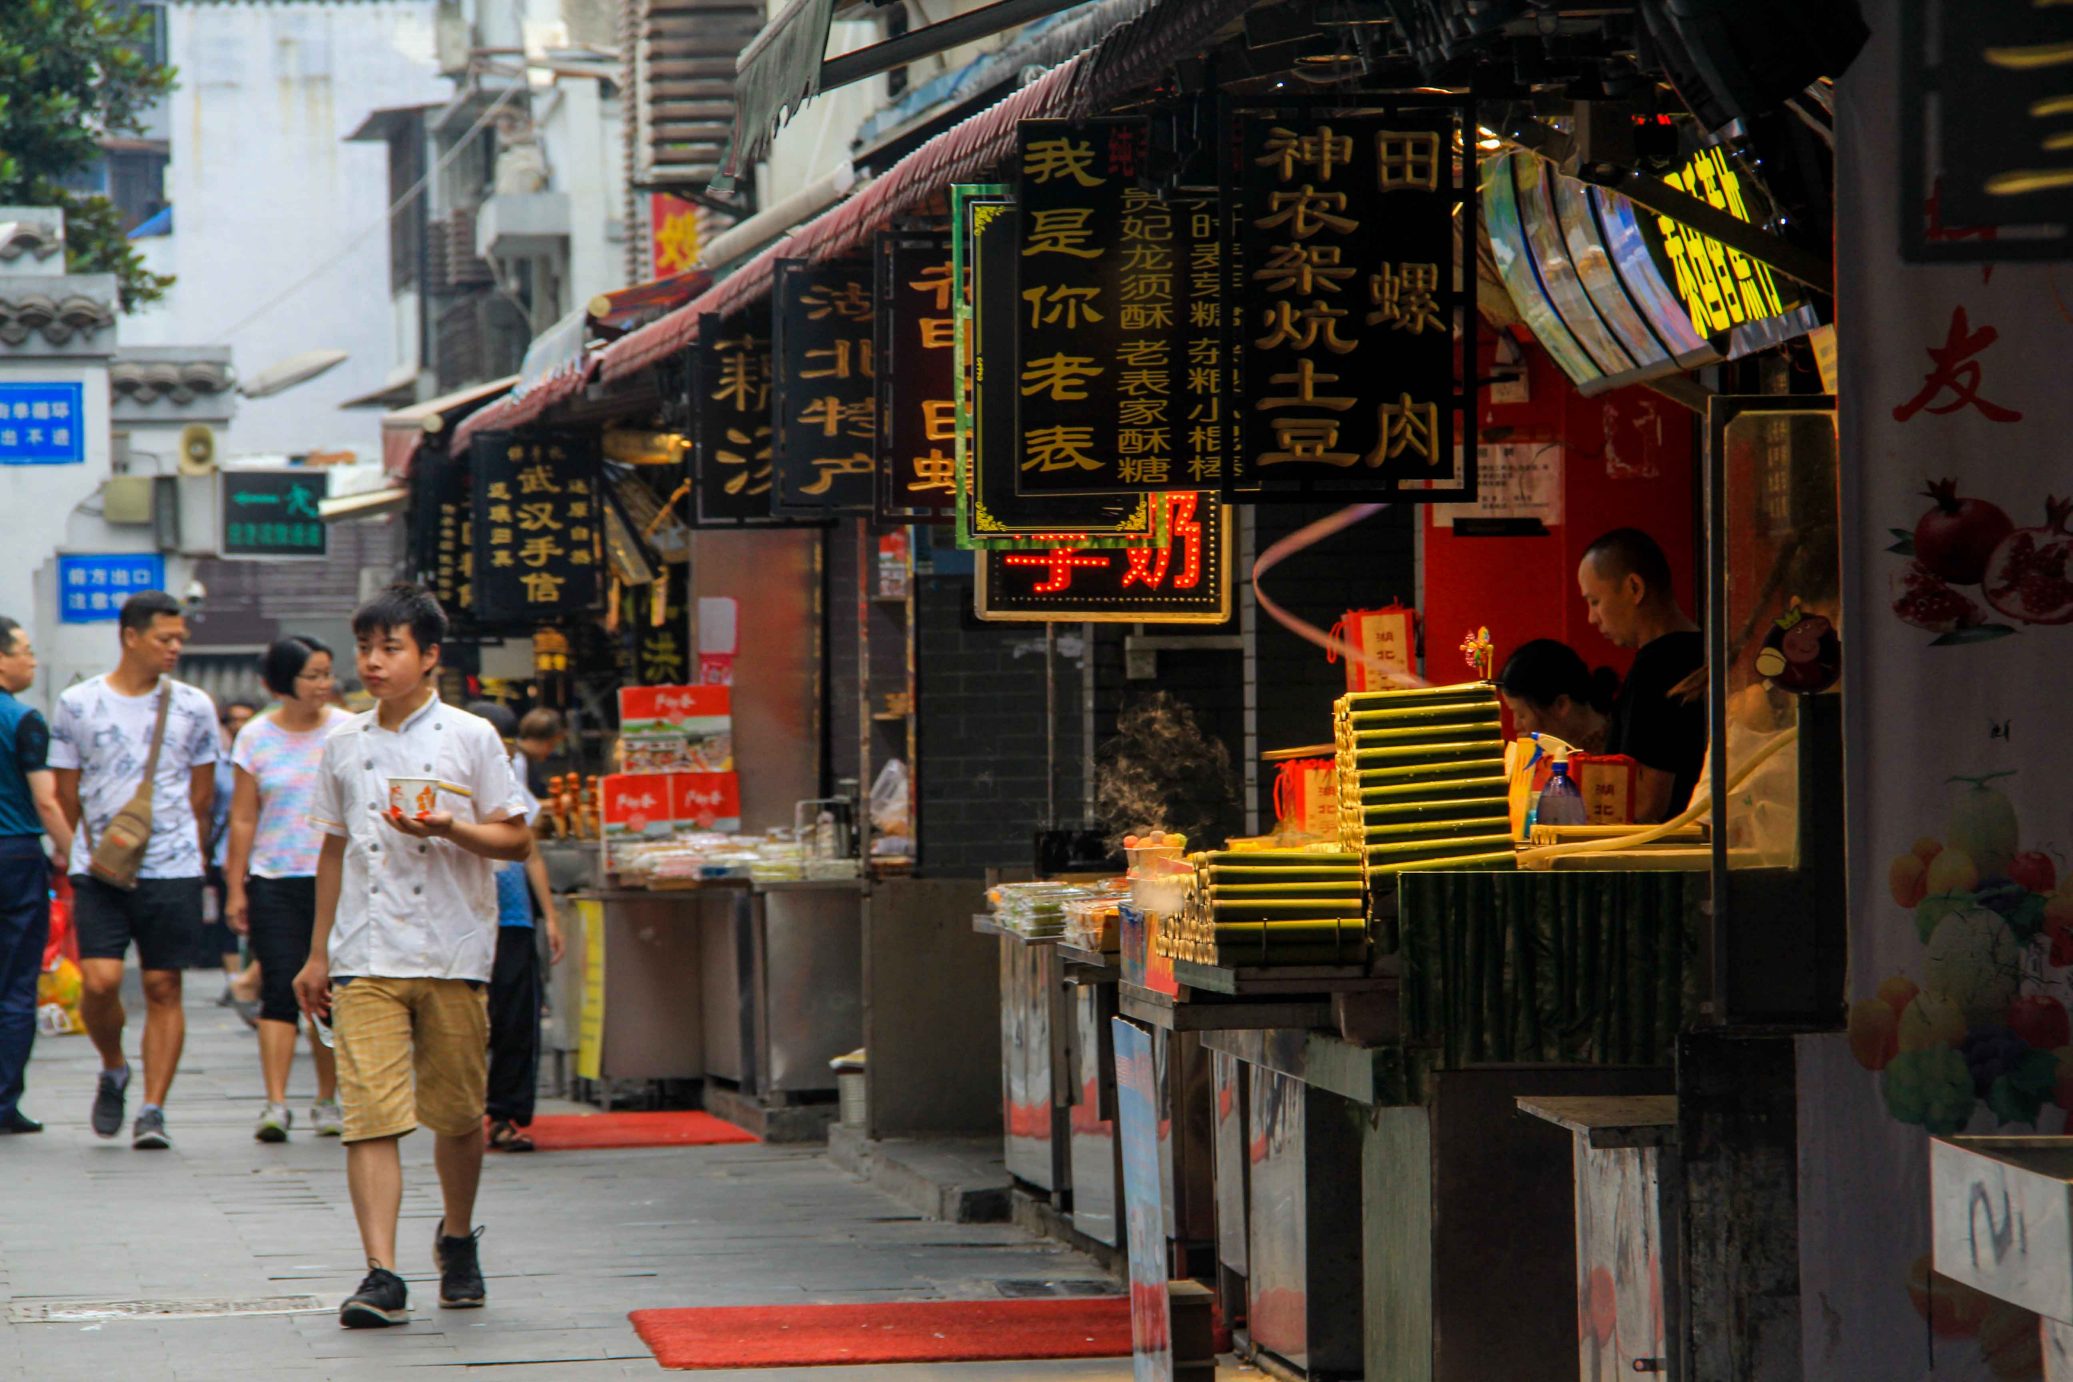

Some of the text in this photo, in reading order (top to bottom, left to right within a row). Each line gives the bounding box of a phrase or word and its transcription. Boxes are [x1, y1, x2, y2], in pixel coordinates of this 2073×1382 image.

[1021, 138, 1106, 472] 我是你老表
[1115, 186, 1174, 484] 贵妃龙须酥 老表家酥糖
[1253, 126, 1360, 467] 神农架炕土豆
[1365, 130, 1447, 468] 田螺肉
[68, 567, 151, 585] 前方出口
[516, 464, 566, 602] 武汉手信
